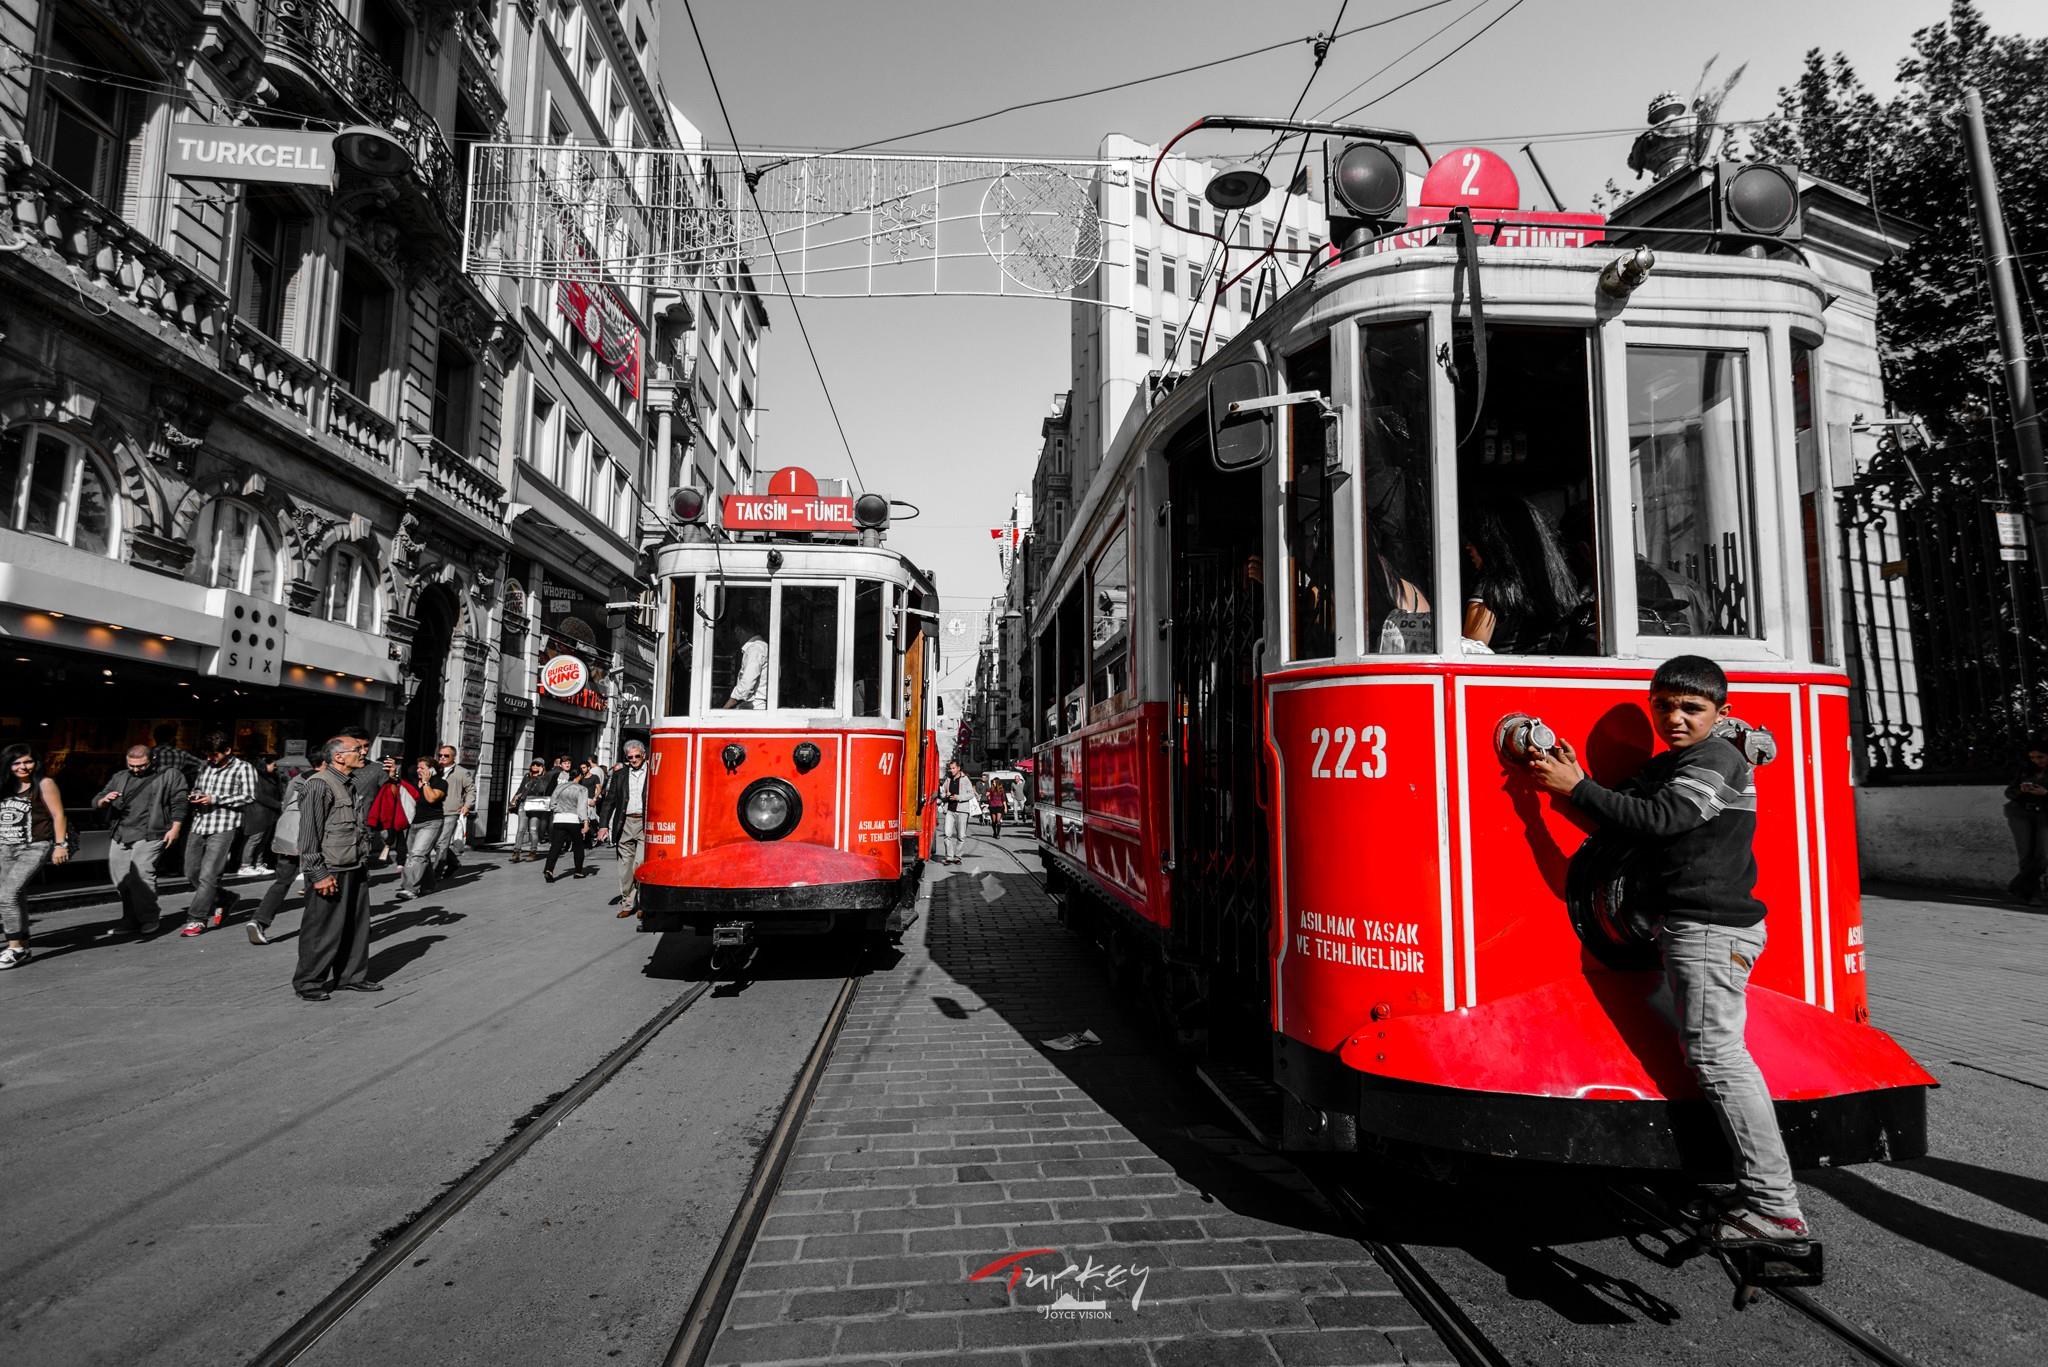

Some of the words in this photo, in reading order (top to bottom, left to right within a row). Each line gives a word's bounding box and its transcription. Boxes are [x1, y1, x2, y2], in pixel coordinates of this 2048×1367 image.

[178, 138, 326, 170] TURKCELL
[1461, 153, 1481, 196] 2
[789, 470, 796, 493] 1
[735, 499, 788, 521] TAKSİM
[804, 500, 853, 522] TÜNEL
[543, 585, 577, 600] WHOPPER
[228, 652, 272, 674] SIX
[547, 662, 579, 678] BURGER
[548, 670, 580, 687] KING
[878, 752, 894, 775] 47
[1311, 725, 1387, 779] 223
[858, 833, 867, 843] VE
[1300, 910, 1356, 938] ASILMAK
[1363, 918, 1420, 945] YASAK
[1296, 933, 1311, 956] VE
[1315, 938, 1425, 974] TEHLİKELİDİR
[1844, 953, 1858, 974] VE
